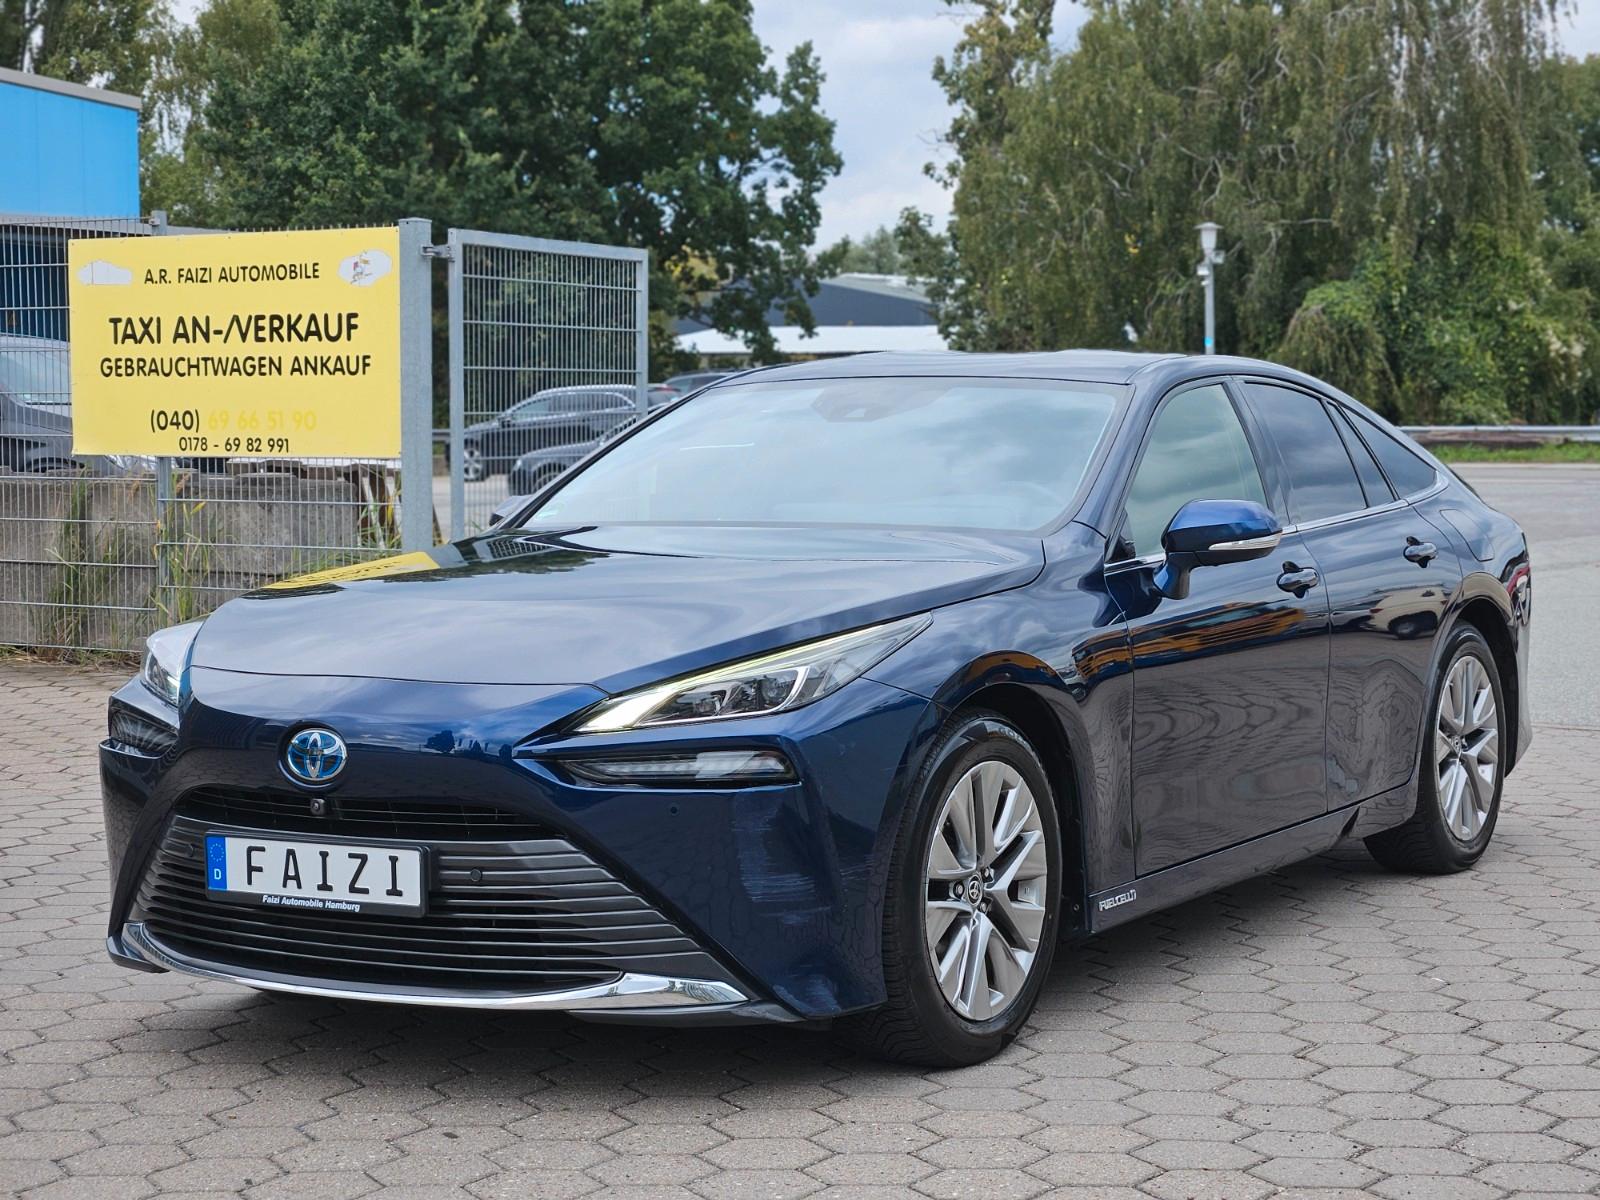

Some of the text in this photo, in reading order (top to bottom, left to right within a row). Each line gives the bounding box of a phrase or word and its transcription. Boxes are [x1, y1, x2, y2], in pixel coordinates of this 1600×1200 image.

[144, 262, 320, 285] A.R. FAIZI AUTOMOBILE
[109, 316, 162, 345] TAXI
[99, 354, 372, 378] GEBRAUCHTWAGEN ANKAUF
[150, 408, 200, 433] (040)
[208, 411, 230, 430] 69
[237, 411, 260, 430] 66
[293, 411, 317, 431] 90
[178, 436, 208, 452] 0178
[224, 437, 241, 453] 69
[246, 437, 263, 453] 82
[267, 438, 290, 454] 991
[213, 868, 222, 881] D
[246, 845, 403, 897] FAIZI
[262, 894, 360, 913] Faizi Automobile Hamburg
